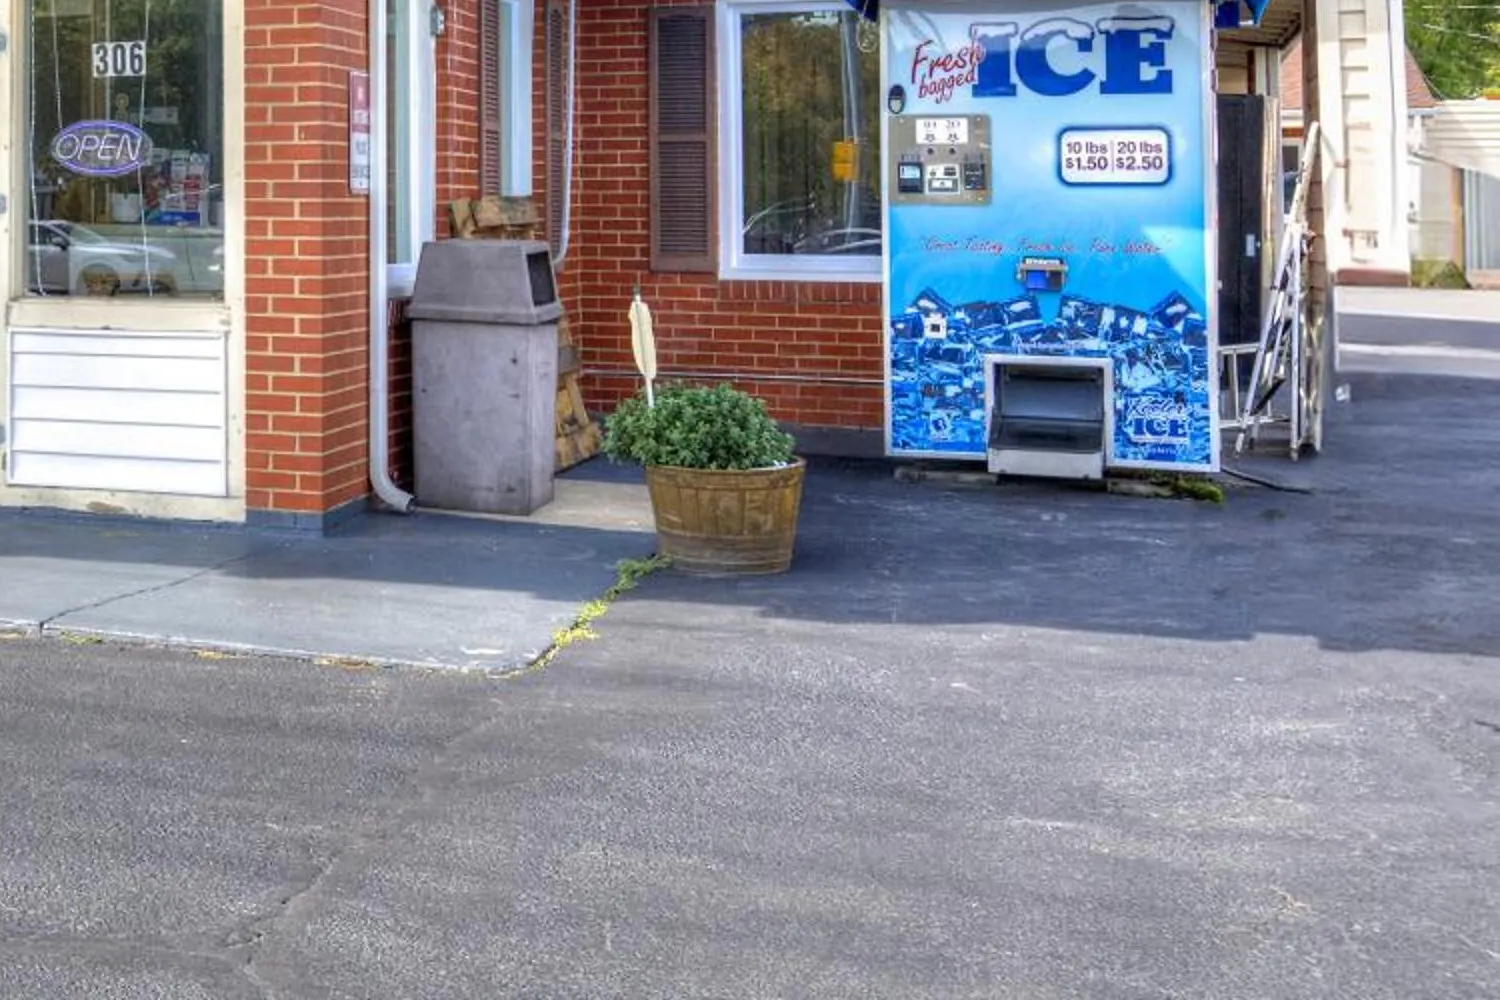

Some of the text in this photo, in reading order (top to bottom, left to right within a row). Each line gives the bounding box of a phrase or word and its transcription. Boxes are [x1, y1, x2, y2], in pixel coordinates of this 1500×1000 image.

[95, 43, 143, 75] 306
[911, 29, 986, 84] Fresh
[969, 15, 1175, 97] ICE
[919, 56, 977, 105] bagged
[55, 133, 142, 161] OPEN
[1066, 141, 1108, 154] 10 lbs
[1117, 141, 1163, 154] 20 lbs
[1065, 155, 1108, 170] $1.50
[1115, 155, 1164, 170] $2.50
[1132, 415, 1188, 437] ICE
